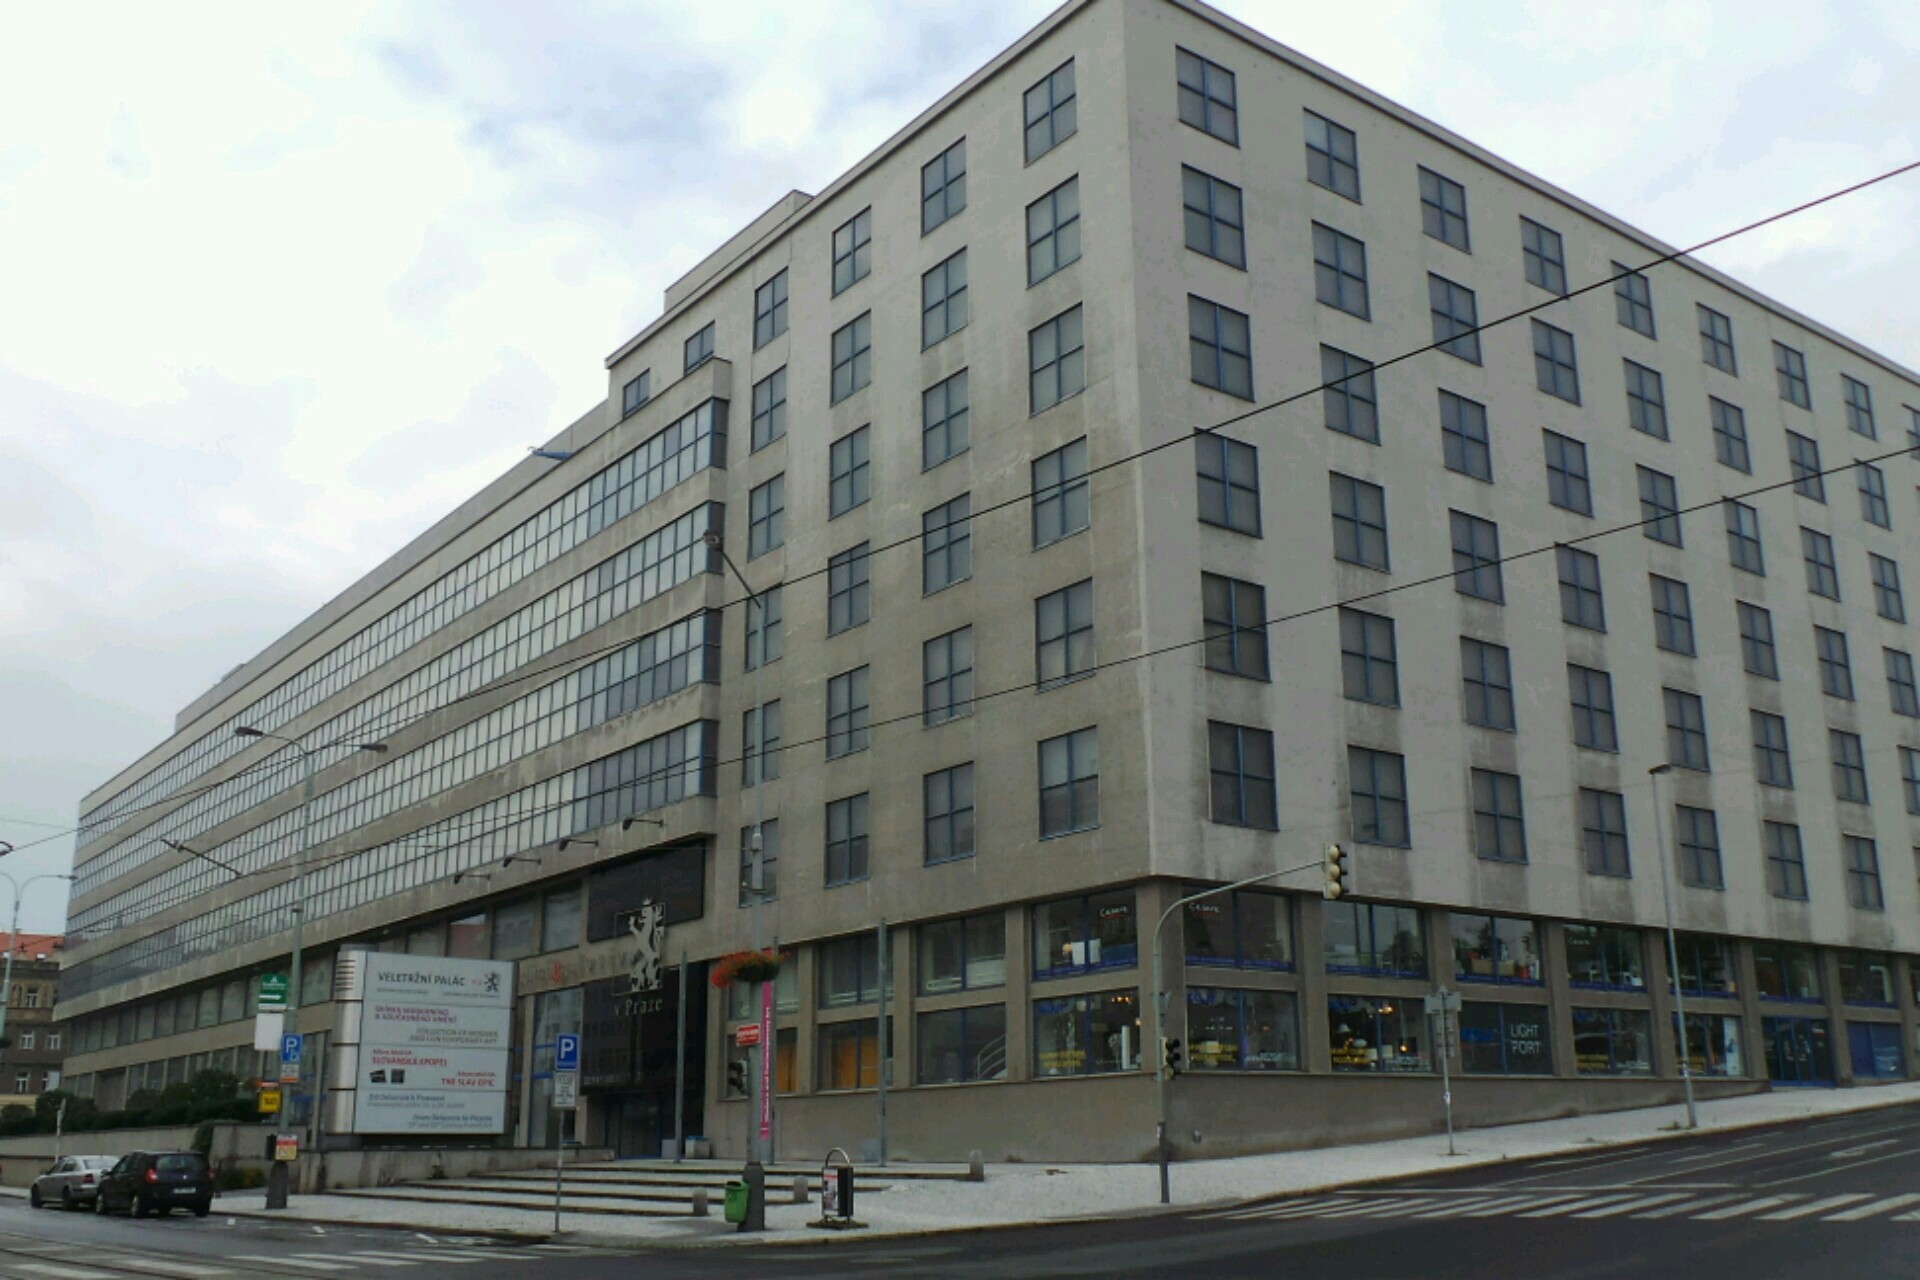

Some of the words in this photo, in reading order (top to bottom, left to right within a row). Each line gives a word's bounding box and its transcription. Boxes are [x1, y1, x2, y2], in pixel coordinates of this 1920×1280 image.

[434, 974, 465, 986] PALÁC
[625, 998, 663, 1017] Praze
[285, 1038, 298, 1054] P
[560, 1038, 575, 1060] P
